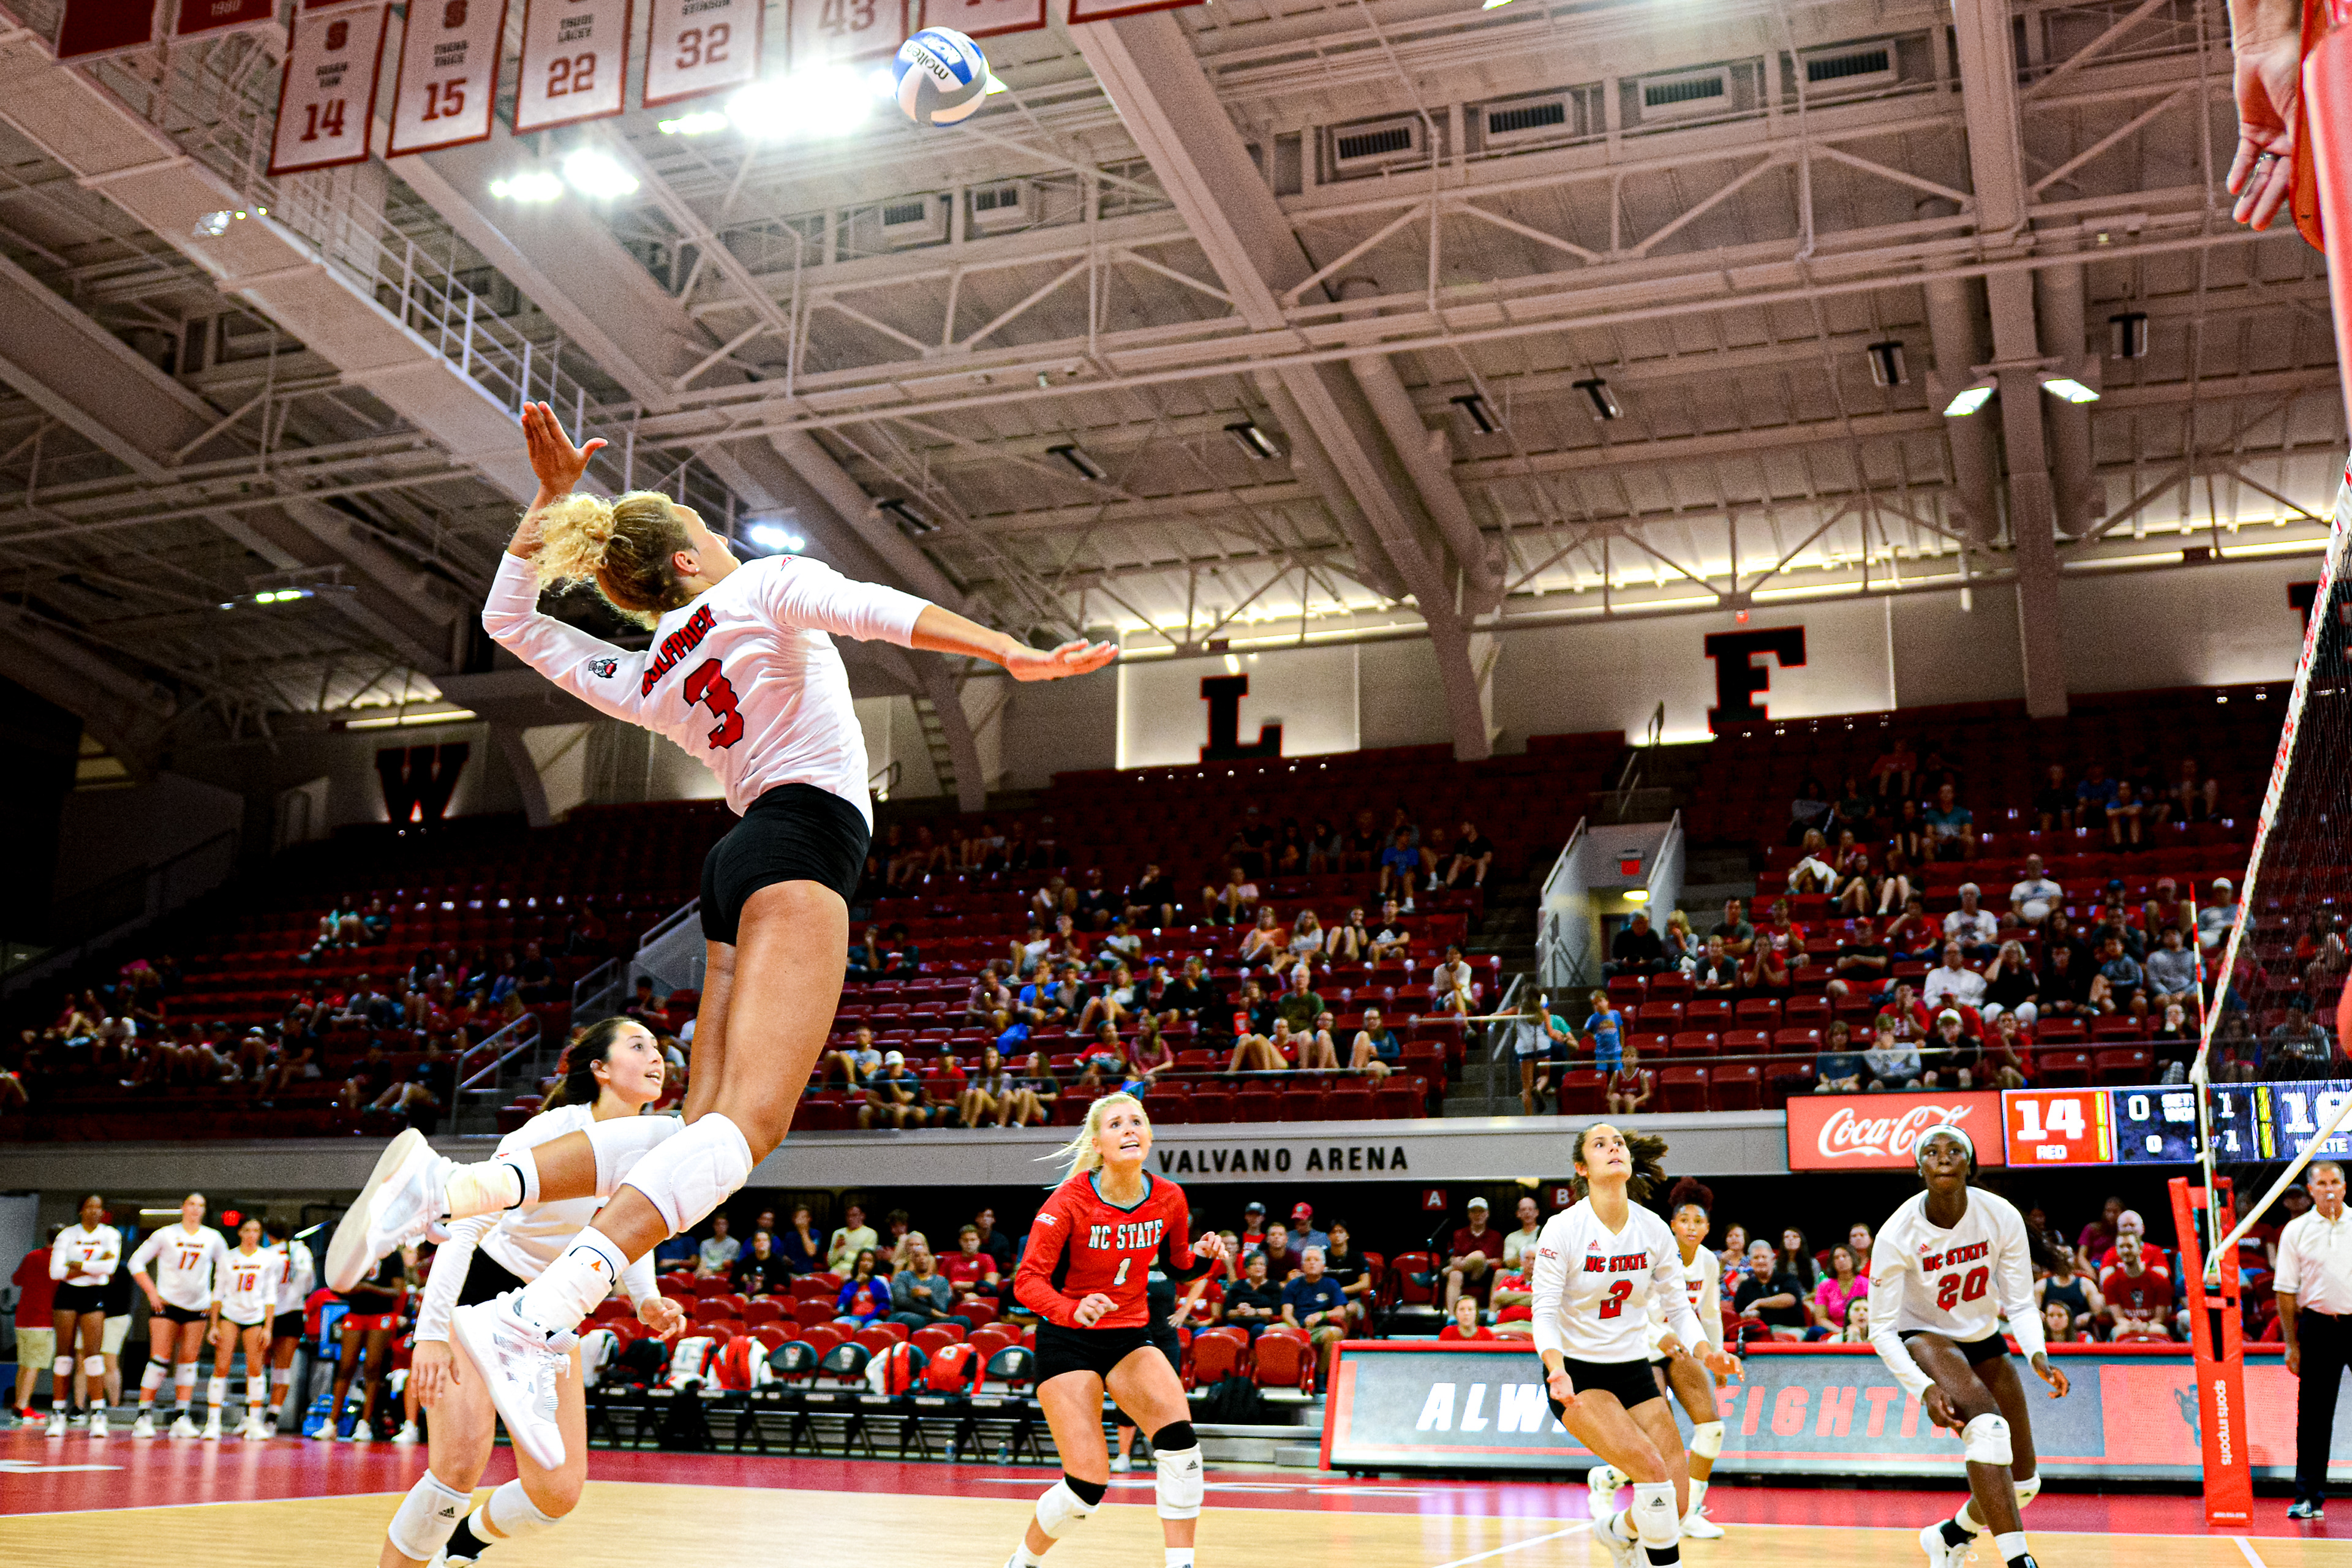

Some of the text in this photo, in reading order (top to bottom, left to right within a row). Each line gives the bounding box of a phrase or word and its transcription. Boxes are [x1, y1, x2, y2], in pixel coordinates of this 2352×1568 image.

[676, 23, 730, 69] 32
[907, 43, 949, 80] molten
[546, 51, 597, 99] 22
[421, 77, 467, 121] 15
[300, 99, 345, 142] 14
[1705, 625, 1807, 733] F
[683, 657, 745, 750] 3
[1200, 674, 1283, 763] L
[375, 742, 470, 822] W
[2015, 1099, 2085, 1140] 14
[2128, 1095, 2150, 1121] 0
[2218, 1091, 2236, 1118] 1
[2037, 1144, 2067, 1159] RED
[2146, 1134, 2163, 1153] 0
[2223, 1129, 2241, 1152] 1
[1158, 1146, 1408, 1174] VALVANO ARENA
[1427, 1191, 1442, 1207] A
[1556, 1188, 1570, 1205] B
[1088, 1218, 1163, 1250] NC STATE
[83, 1248, 95, 1261] 7
[179, 1250, 201, 1270] 17
[1583, 1251, 1648, 1272] NC STATE
[1923, 1240, 1989, 1272] NC STATE
[1113, 1257, 1132, 1286] 1
[1937, 1265, 1989, 1311] 20
[2213, 1379, 2233, 1466] sports imports
